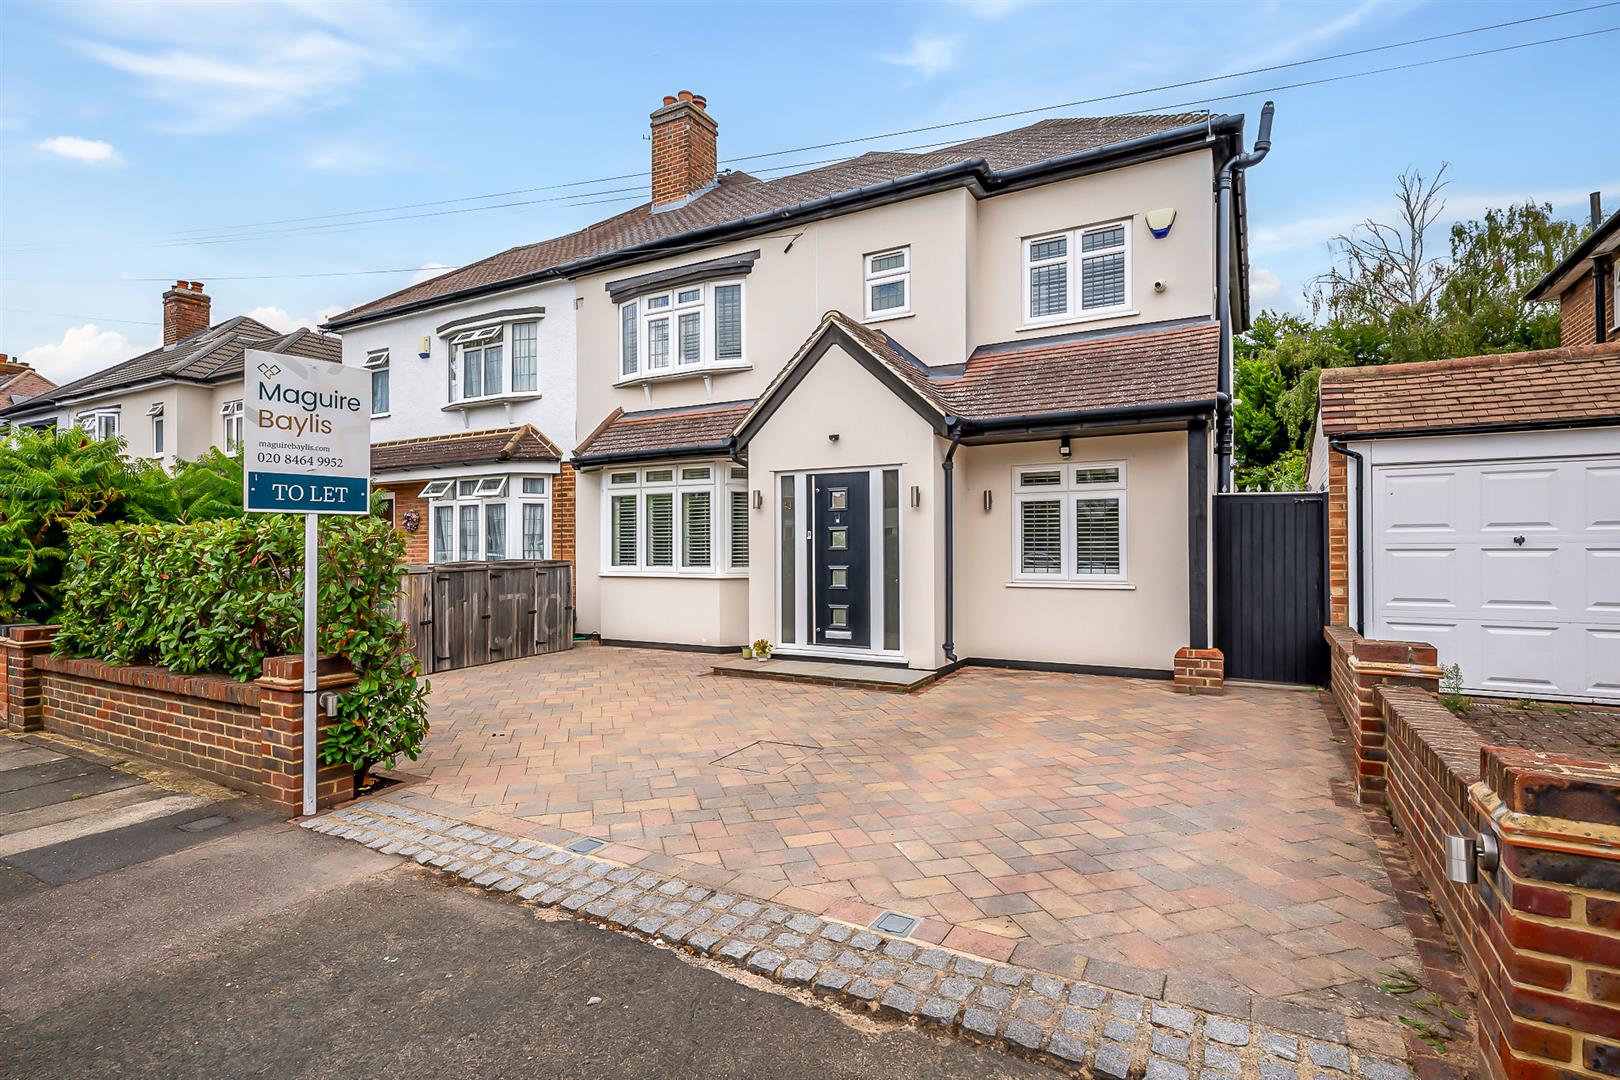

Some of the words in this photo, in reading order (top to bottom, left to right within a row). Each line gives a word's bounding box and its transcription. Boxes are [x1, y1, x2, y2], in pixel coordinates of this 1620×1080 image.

[259, 381, 361, 412] Maguire
[258, 409, 333, 437] Baylis
[258, 441, 330, 452] maguirebaylis.com
[257, 452, 281, 464] 020
[284, 454, 314, 466] 8464
[317, 456, 344, 468] 9952
[272, 484, 304, 501] TO
[309, 485, 348, 502] LET
